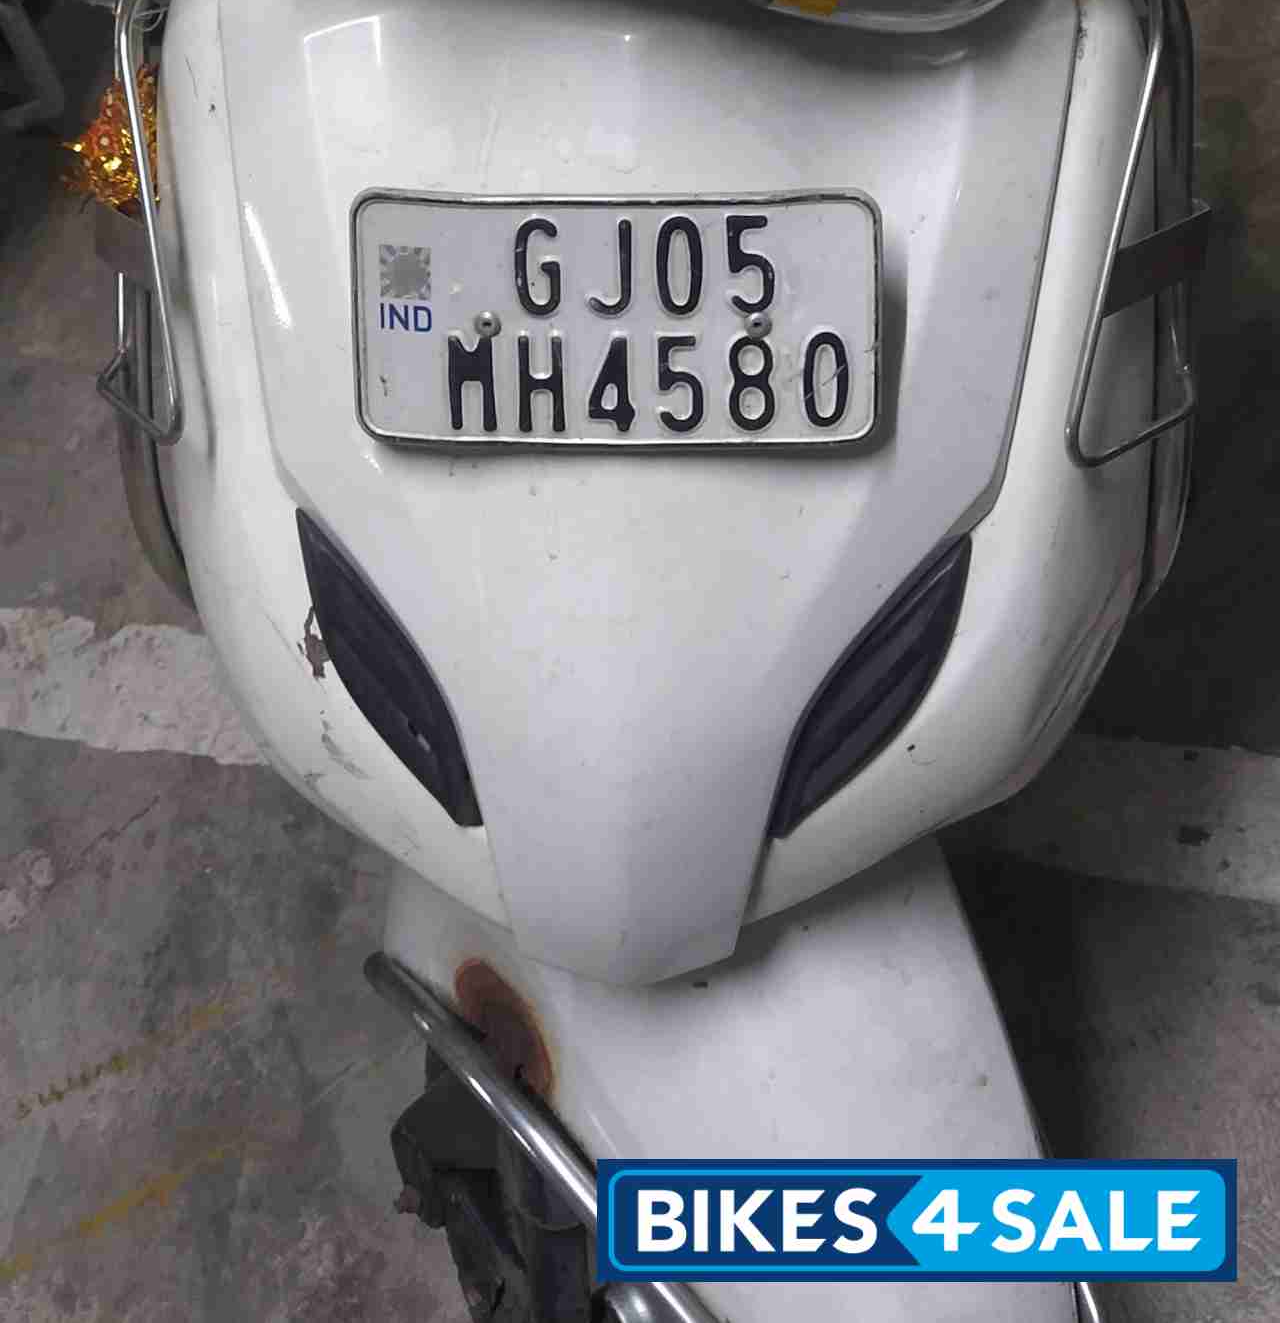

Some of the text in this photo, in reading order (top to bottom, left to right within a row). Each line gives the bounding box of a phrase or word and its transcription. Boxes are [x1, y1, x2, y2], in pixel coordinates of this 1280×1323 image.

[515, 215, 775, 316] GJ05
[380, 302, 432, 333] IND
[447, 330, 849, 433] MH4580
